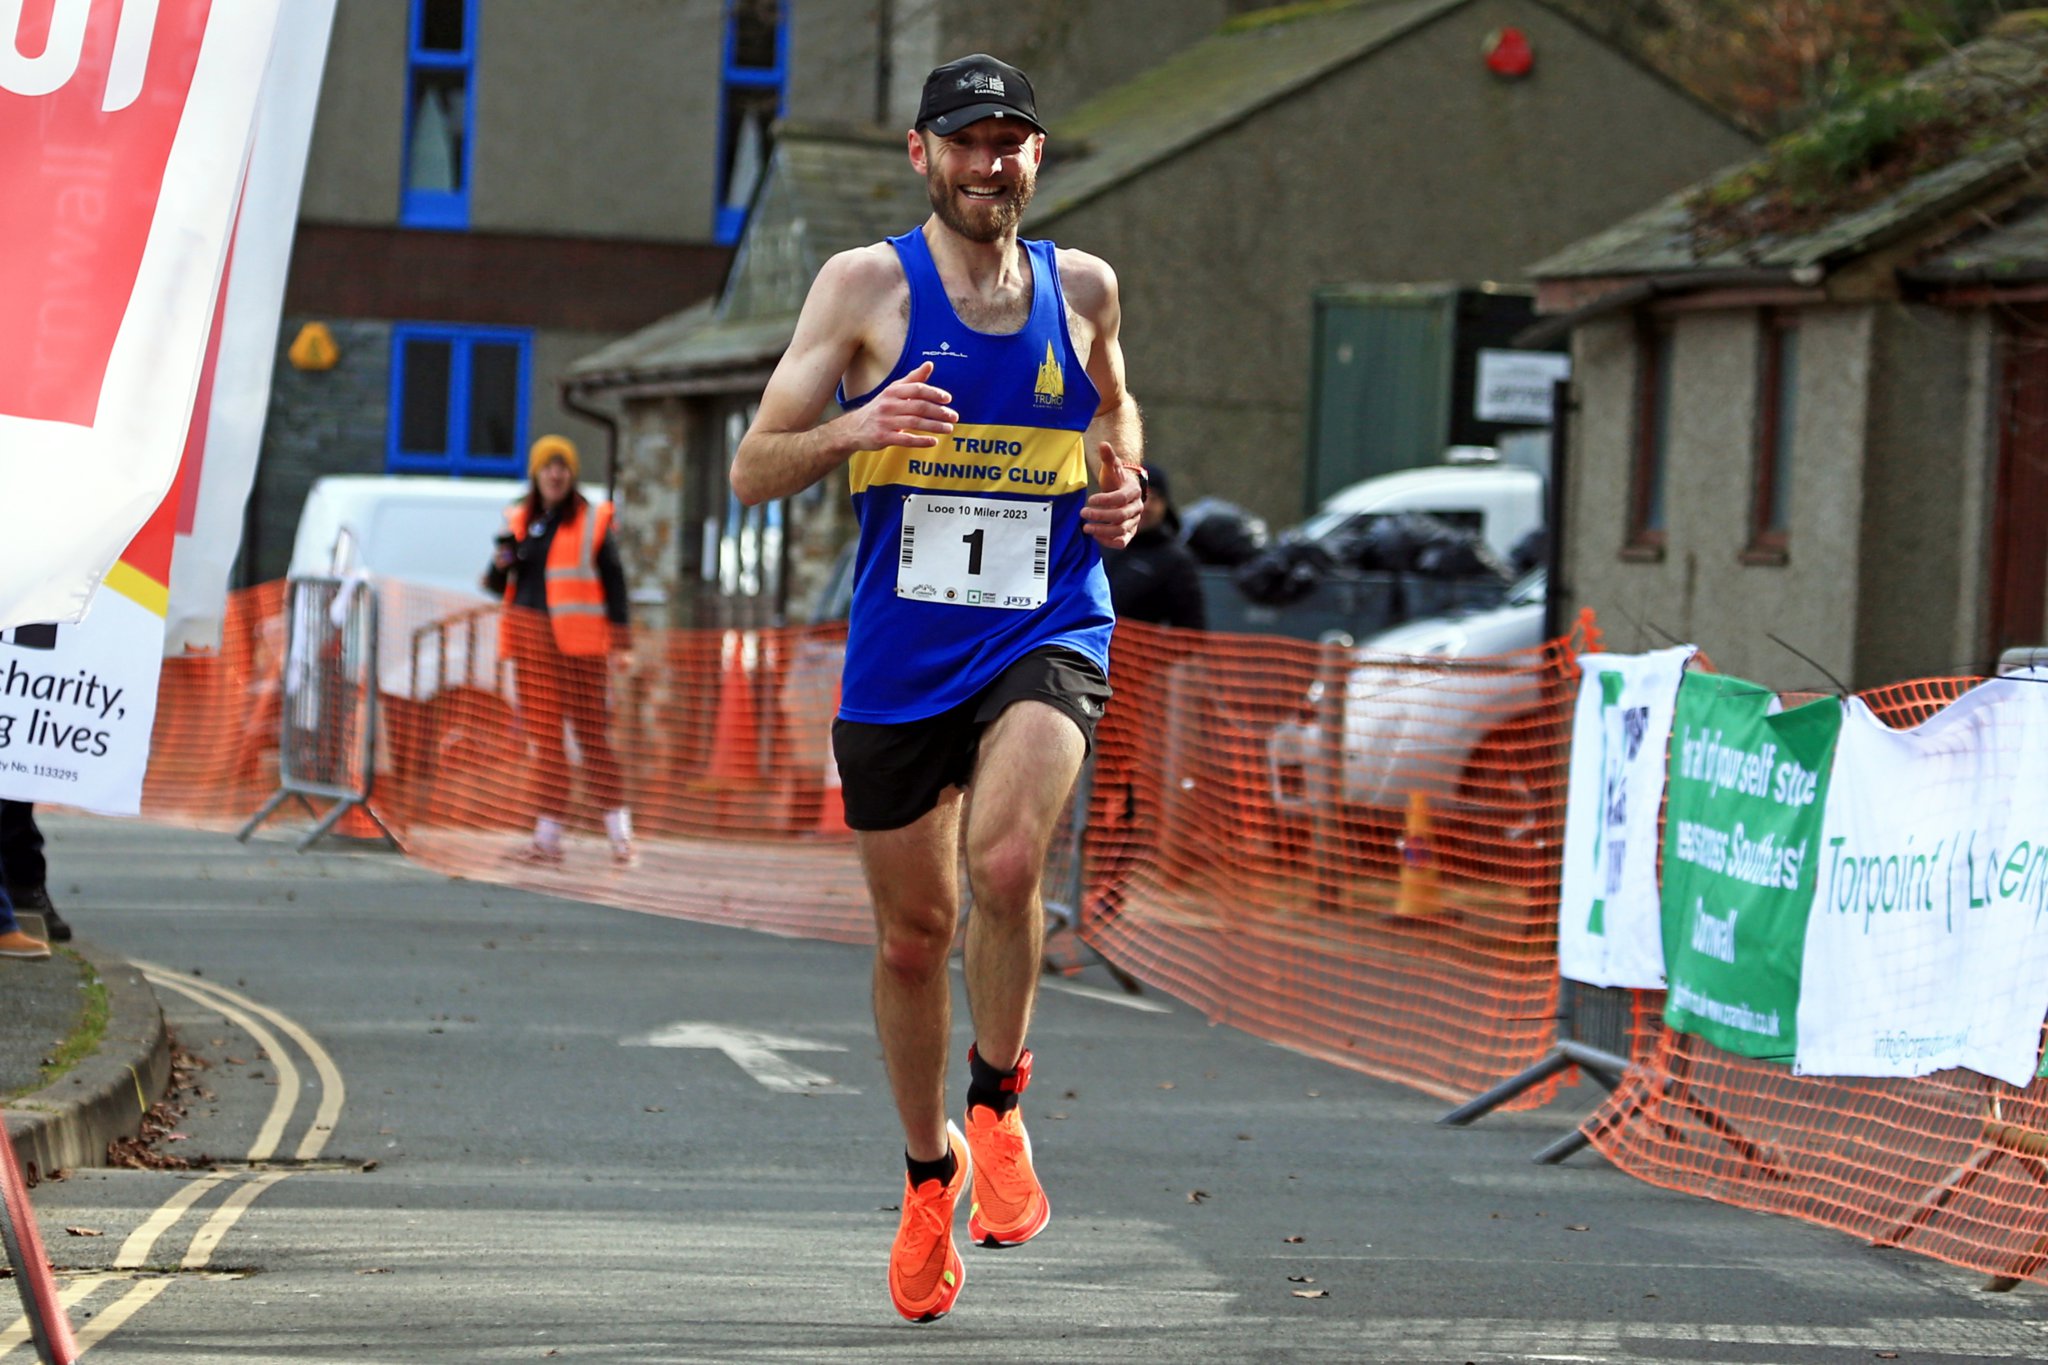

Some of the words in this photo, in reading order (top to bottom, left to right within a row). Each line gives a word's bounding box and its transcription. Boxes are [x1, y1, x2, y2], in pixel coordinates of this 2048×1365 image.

[922, 351, 968, 359] RONHILL
[1034, 394, 1064, 406] TRURO
[953, 437, 1023, 456] TRURO
[908, 459, 1002, 481] RUNNING
[1008, 467, 1058, 486] CLUB
[928, 503, 955, 515] Looe
[959, 505, 970, 516] 10
[974, 506, 1000, 518] Miler
[1003, 508, 1028, 520] 2023
[962, 528, 985, 576] 1
[27, 708, 111, 757] lives
[11, 761, 29, 774] No.
[34, 764, 78, 782] 1133295
[1738, 743, 1777, 798] self
[1827, 834, 1945, 934] Torpoint
